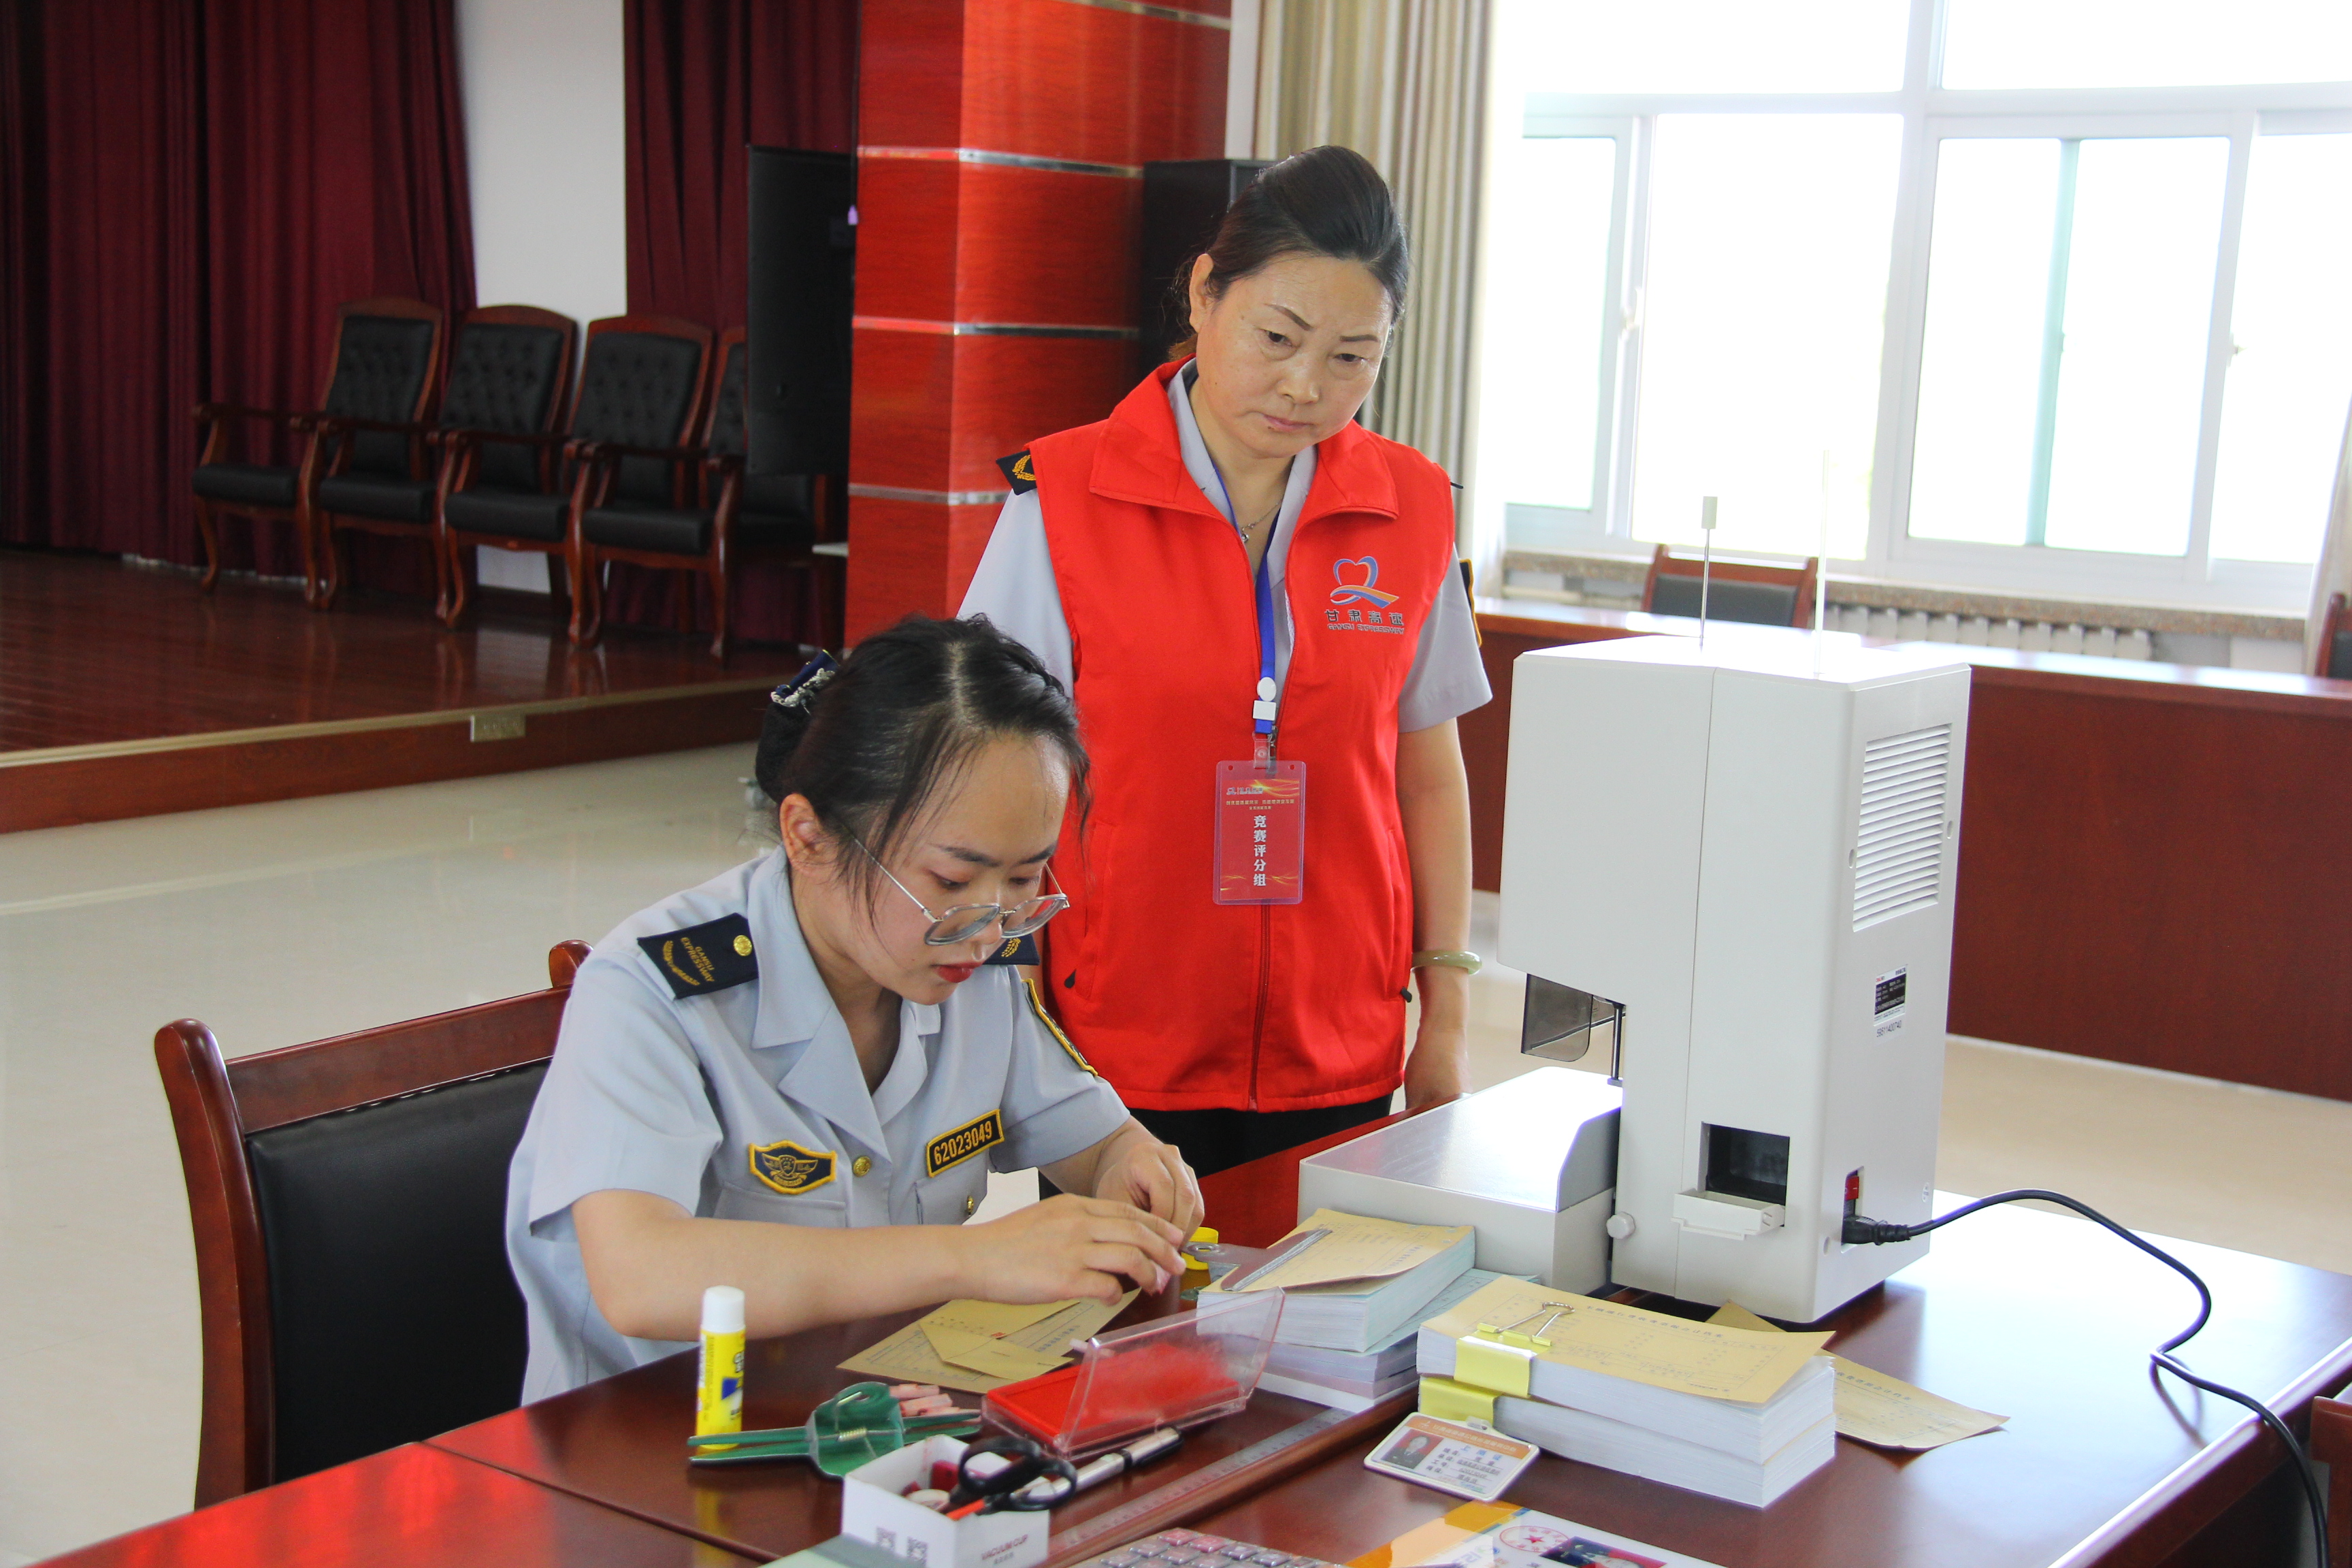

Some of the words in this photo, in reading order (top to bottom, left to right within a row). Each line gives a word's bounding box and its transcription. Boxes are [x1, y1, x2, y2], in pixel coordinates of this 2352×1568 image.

[1324, 608, 1404, 625] 甘肃高速
[1357, 623, 1405, 634] EXPRESSWAY
[1253, 815, 1267, 886] 竞赛评分组
[681, 937, 715, 982] EXPRESSWAY
[695, 946, 715, 970] GANSU
[934, 1121, 992, 1165] 62023049
